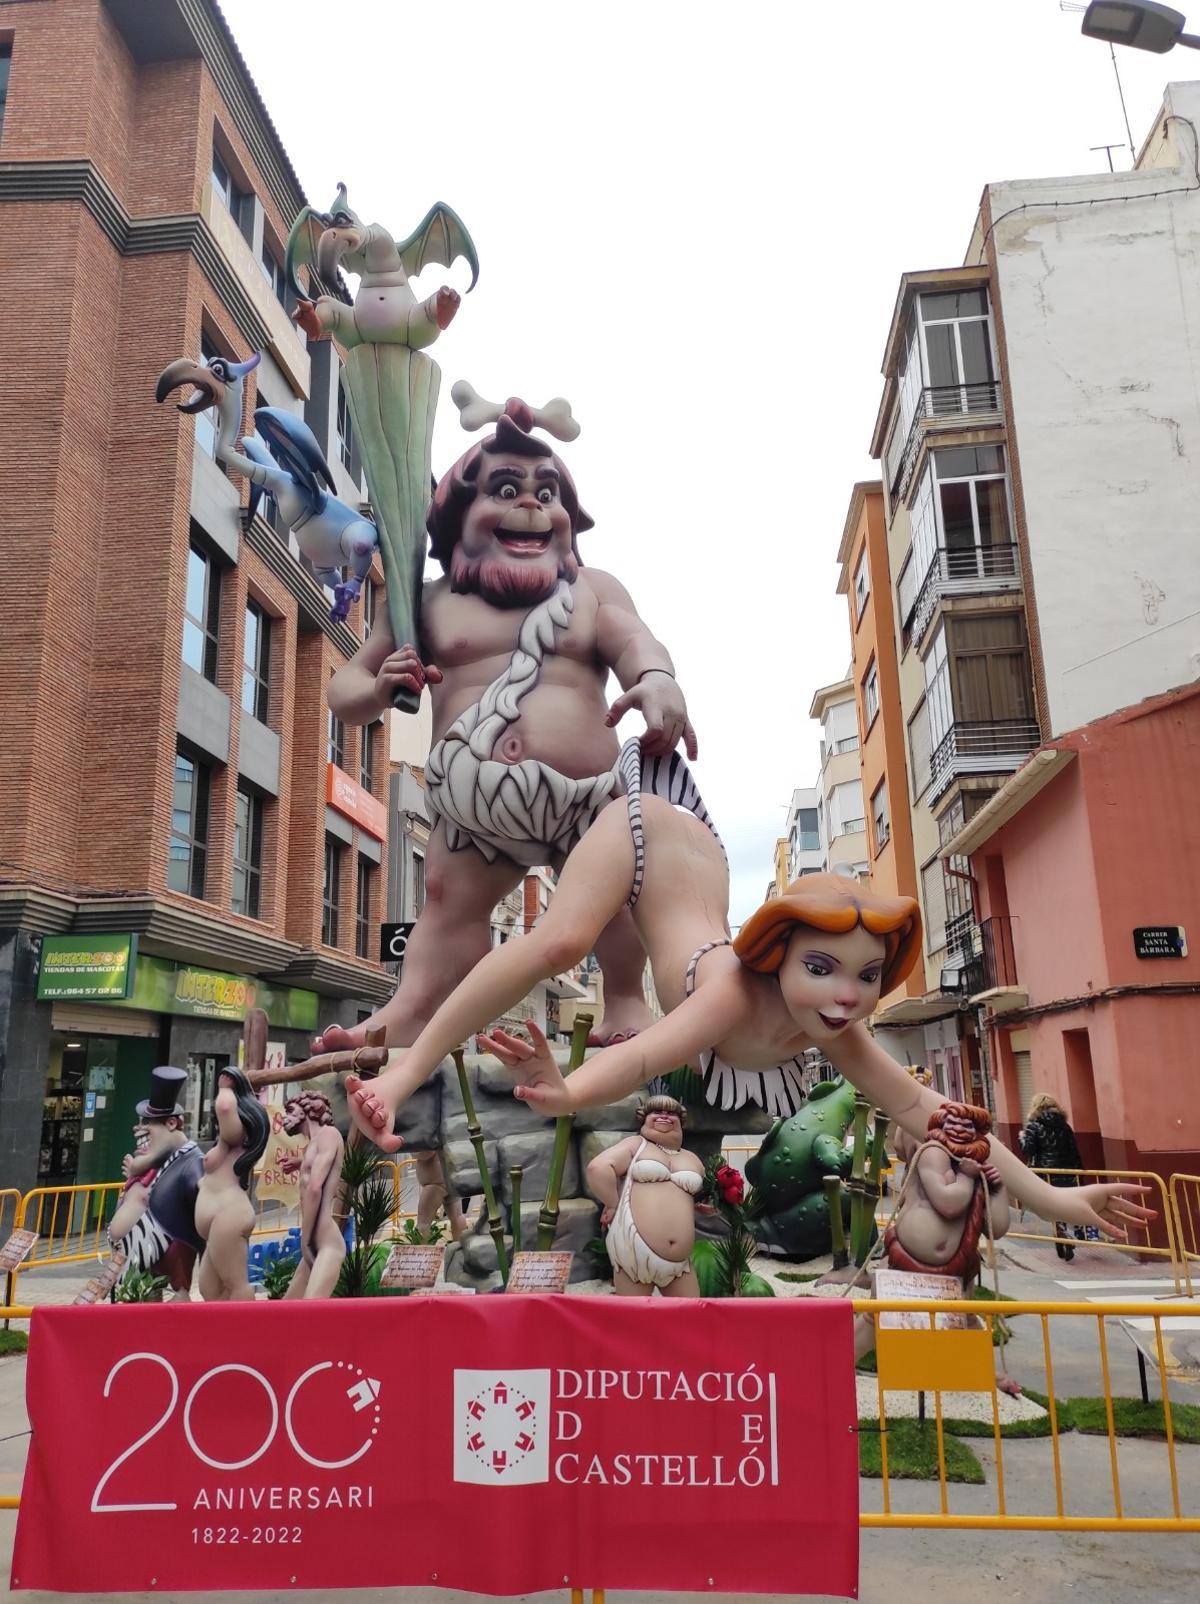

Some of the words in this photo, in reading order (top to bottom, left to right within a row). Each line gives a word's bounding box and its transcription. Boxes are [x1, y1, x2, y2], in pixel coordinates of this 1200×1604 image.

[1144, 938, 1169, 946] SANTA
[556, 1363, 764, 1402] DIPUTACIÓ
[555, 1447, 766, 1487] CASTELLÓ
[193, 1486, 374, 1510] ANIVERSARI
[191, 1527, 303, 1544] 1822-2022
